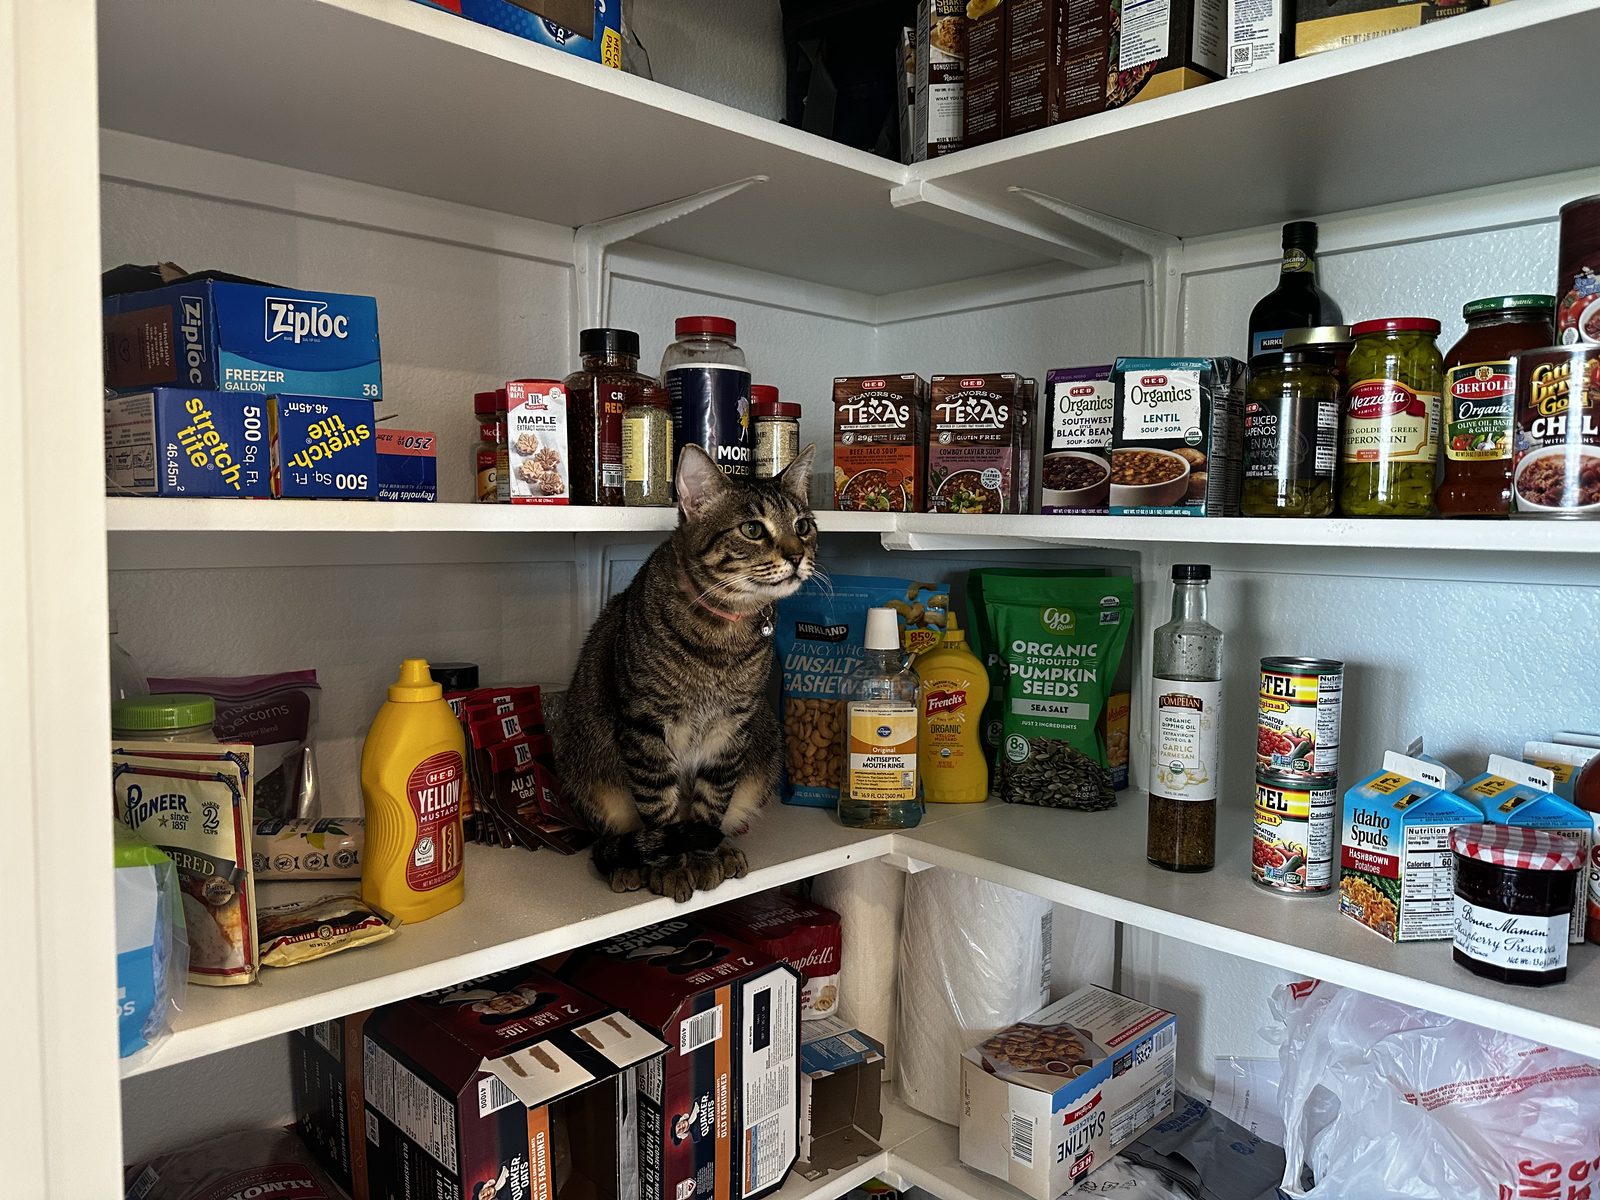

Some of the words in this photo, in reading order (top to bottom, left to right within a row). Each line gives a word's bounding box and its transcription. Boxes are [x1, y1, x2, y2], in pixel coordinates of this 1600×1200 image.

[1436, 6, 1467, 16] EXCELLENT
[604, 34, 613, 65] PACK
[612, 37, 620, 70] MEGA
[271, 302, 349, 344] Ziploc
[181, 302, 203, 385] Ziploc
[225, 368, 285, 384] FREEZER
[225, 382, 265, 393] GALLON
[362, 383, 379, 397] 38
[848, 391, 889, 403] FLAVORS
[945, 390, 988, 402] FLAVORS
[989, 392, 1002, 401] OF
[1130, 385, 1192, 408] Organics
[1347, 390, 1405, 412] Mezzetta
[605, 402, 623, 414] RED
[1059, 395, 1113, 416] Organics
[1459, 401, 1512, 420] Organic
[517, 416, 557, 425] MAPLE
[839, 399, 910, 429] TEXAS
[935, 399, 1009, 429] TEXAS
[1062, 416, 1113, 426] SOUTHWEST
[1143, 413, 1180, 424] LENTIL
[1252, 415, 1278, 426] SLICED
[243, 405, 262, 442] 500
[308, 414, 341, 444] tite
[1140, 426, 1159, 434] SOUP
[1164, 425, 1182, 433] SOPA
[1457, 422, 1479, 430] OLIVE
[1479, 420, 1492, 429] OIL,
[1475, 426, 1500, 434] GARLIC
[857, 434, 873, 443] 29g
[1056, 429, 1085, 438] BLACK
[1089, 427, 1113, 436] BEAN
[177, 426, 209, 468] tite
[185, 397, 241, 492] stretch-
[287, 423, 370, 470] stretch-
[404, 436, 434, 451] 250
[1251, 439, 1260, 450] EN
[245, 446, 259, 466] Sq.
[849, 448, 865, 456] BEEF
[881, 447, 898, 455] SOUP
[940, 448, 962, 456] COWBOY
[963, 448, 985, 456] CAVIAR
[985, 448, 1001, 456] SOUP
[245, 469, 259, 487] Ft.
[293, 472, 308, 485] Ft.
[310, 471, 333, 486] Sq.
[335, 473, 368, 490] 500
[379, 489, 399, 500] Wrap
[401, 490, 435, 501] Reynolds
[798, 623, 848, 638] KIRKLAND
[1056, 622, 1074, 631] Raw
[910, 631, 936, 644] 85%
[791, 642, 835, 657] FANCY
[1012, 640, 1098, 657] ORGANIC
[1026, 656, 1080, 667] SPROUTED
[1009, 663, 1097, 683] PUMPKIN
[1022, 680, 1079, 698] SEEDS
[928, 694, 963, 711] French's
[1030, 703, 1048, 712] SEA
[1048, 705, 1069, 714] SALT
[1160, 696, 1200, 708] POMPEIAN
[1038, 722, 1077, 730] INGREDIENTS
[1162, 722, 1185, 730] DIPPING
[1164, 716, 1192, 724] ORGANIC
[930, 724, 962, 735] ORGANIC
[872, 747, 896, 755] Original
[1010, 737, 1024, 752] 8g
[1162, 743, 1193, 753] GARLIC
[1160, 751, 1195, 760] PARMESAN
[1421, 772, 1436, 782] OPEN
[1527, 775, 1542, 786] OPEN
[511, 778, 524, 793] AU
[418, 779, 460, 814] YELLOW
[124, 784, 190, 831] PIONEER
[201, 801, 220, 810] MAKES
[170, 811, 190, 822] since
[203, 806, 220, 829] 2
[420, 805, 459, 823] MUSTARD
[1352, 808, 1390, 830] Idaho
[172, 821, 187, 831] 1851
[203, 828, 219, 836] CUPS
[1351, 825, 1389, 848] Spuds
[1348, 847, 1390, 866] HASHBROWN
[1441, 858, 1452, 866] 60
[1354, 859, 1381, 875] Potatoes
[1462, 904, 1494, 930] Bonne
[1494, 917, 1548, 937] Maman
[288, 932, 316, 943] PREMIUM
[607, 921, 689, 954] QUAKER
[1454, 918, 1501, 953] Raspberry
[1503, 937, 1556, 955] Preserves
[1470, 945, 1489, 958] France
[737, 956, 754, 967] 2
[1507, 956, 1519, 964] Net
[561, 1003, 580, 1014] 2
[534, 1018, 551, 1027] LB
[504, 1024, 529, 1039] 110+
[720, 1073, 728, 1122] FASHIONED
[707, 1100, 715, 1125] OATS
[1073, 1102, 1093, 1120] Original
[646, 1107, 655, 1131] IT'S
[1068, 1111, 1097, 1136] CRACKERS
[720, 1121, 728, 1139] OLD
[1056, 1110, 1106, 1164] SALTINE
[646, 1132, 655, 1166] HARD
[536, 1131, 547, 1183] FASHIONED
[520, 1161, 530, 1189] OATS
[646, 1167, 654, 1184] TO
[654, 1170, 660, 1181] TO
[539, 1182, 548, 1200] OLD
